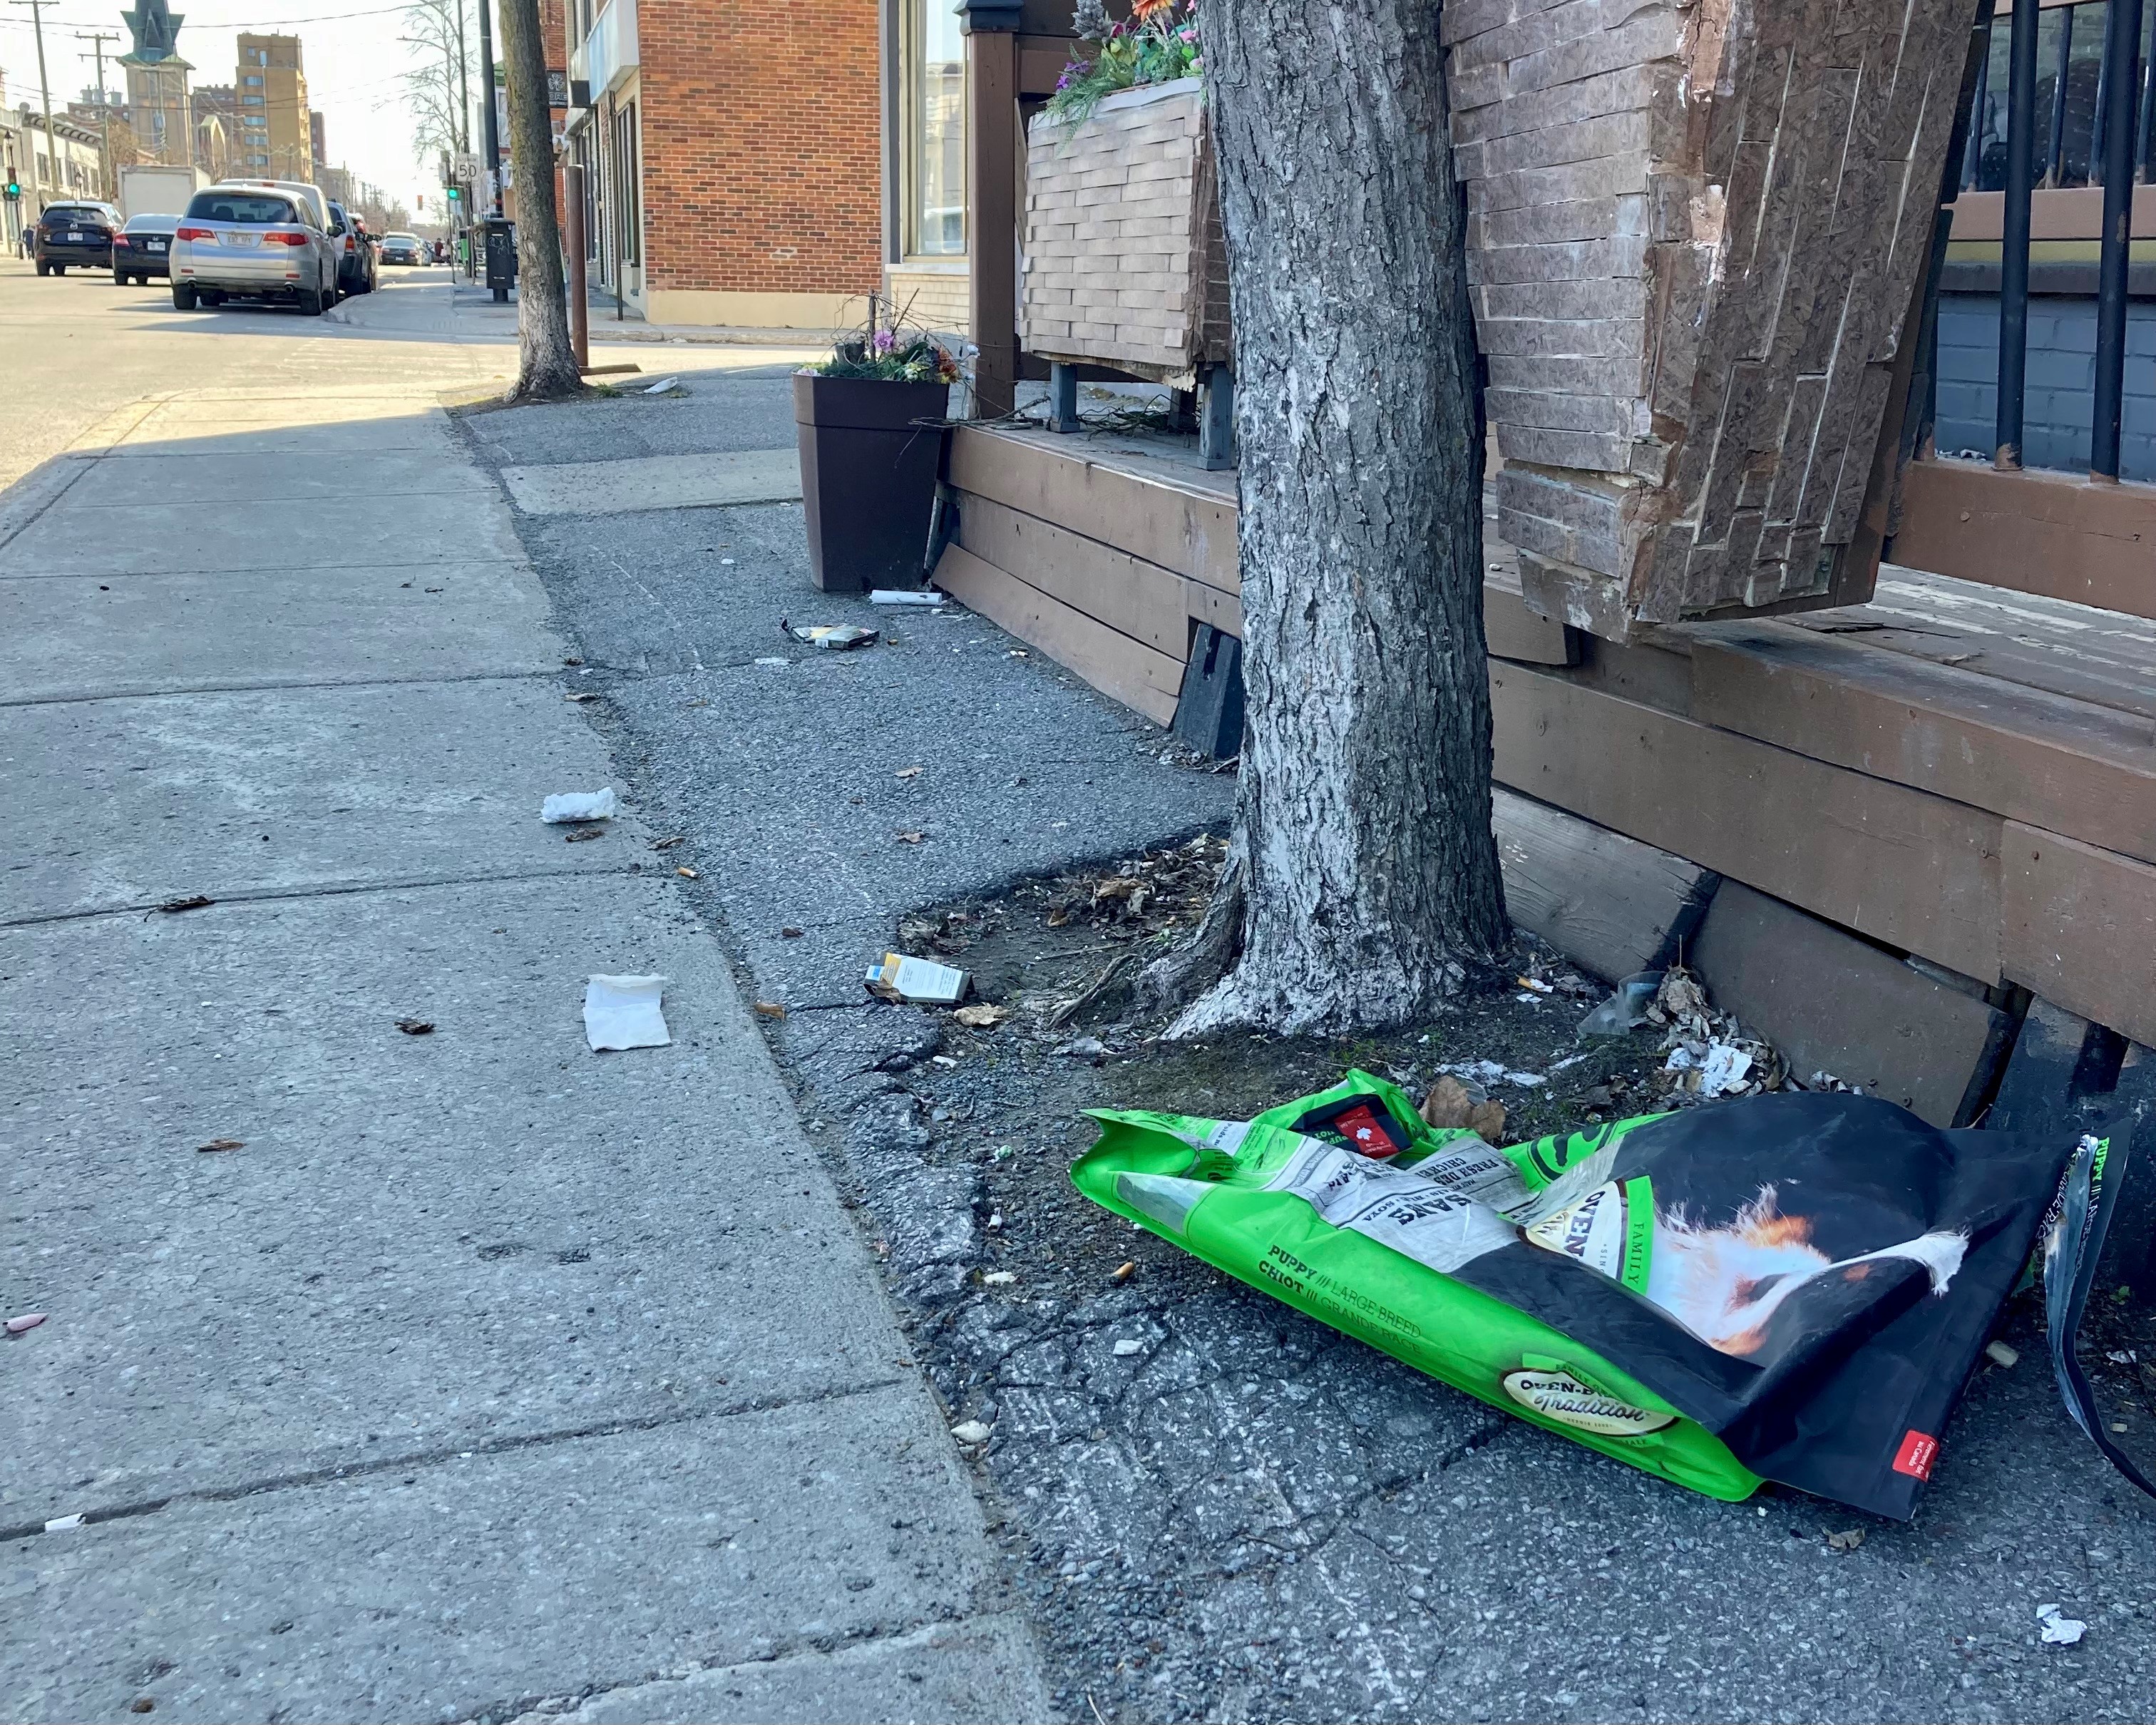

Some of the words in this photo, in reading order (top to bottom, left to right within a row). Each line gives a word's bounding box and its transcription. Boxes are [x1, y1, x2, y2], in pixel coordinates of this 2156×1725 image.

[459, 165, 477, 178] 50
[1461, 1159, 1499, 1178] FRESH
[2093, 1137, 2110, 1182] PUPPY
[1362, 1200, 1395, 1222] SOYA
[1387, 1193, 1472, 1226] SANS
[1628, 1222, 1645, 1285] FAMILY
[1258, 1260, 1304, 1294] CHIOT
[1320, 1296, 1380, 1332] GRANDE
[1381, 1327, 1423, 1355] RACE
[1268, 1244, 1318, 1280] PUPPY
[1330, 1281, 1377, 1315] LARGE
[1377, 1306, 1422, 1338] BREED
[1534, 1393, 1645, 1421] Tradition
